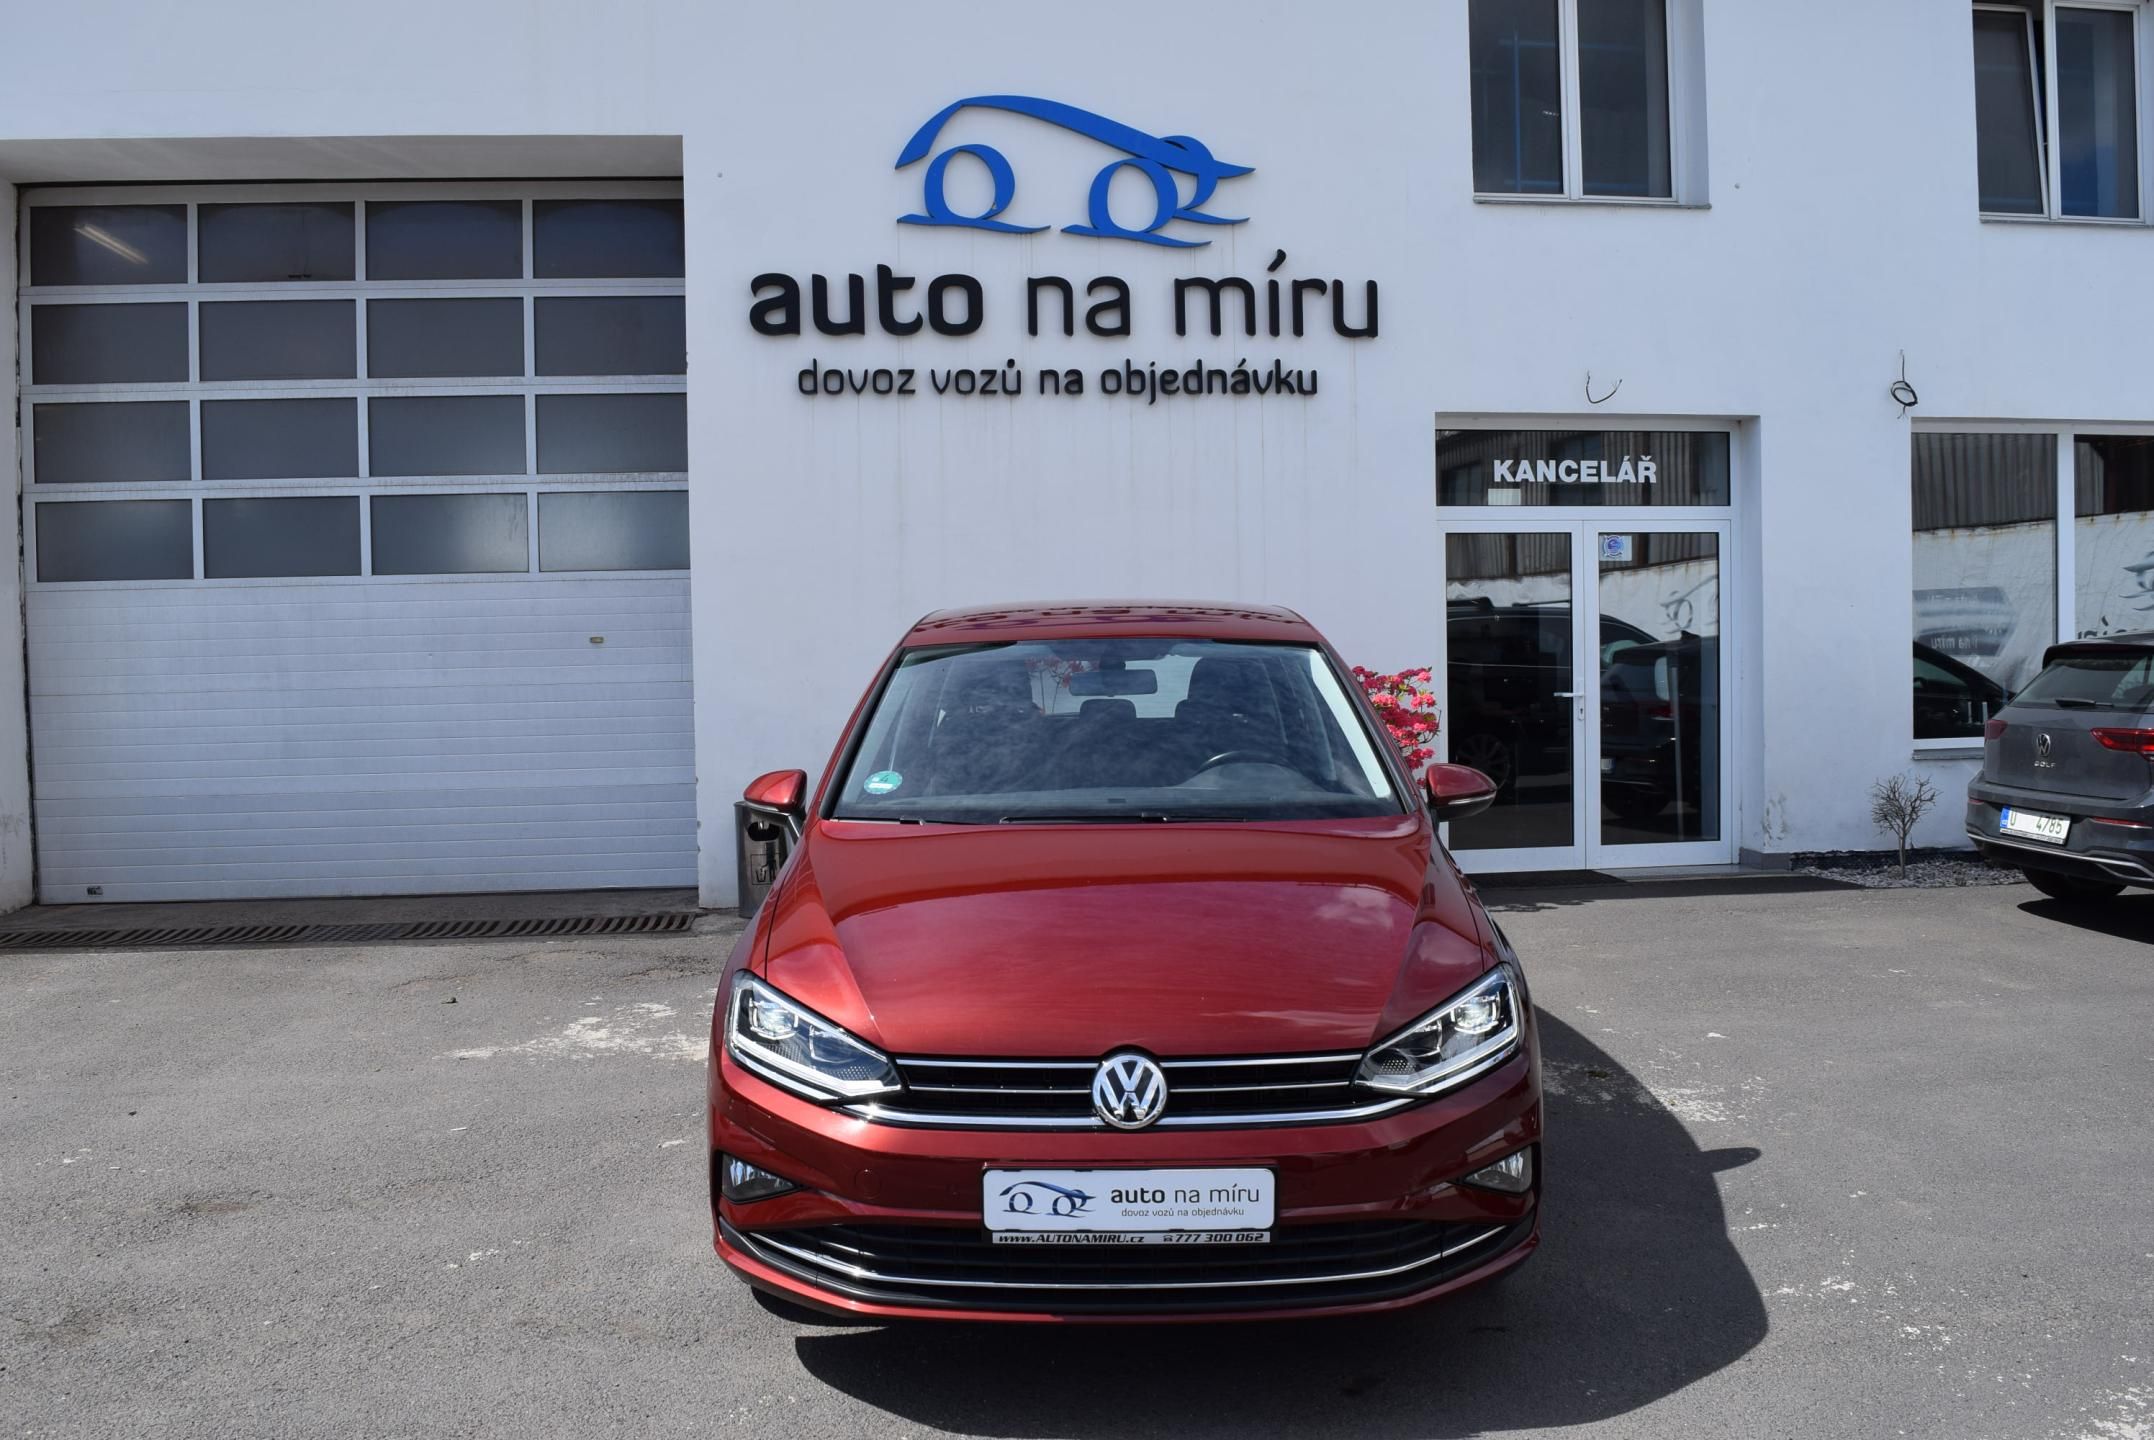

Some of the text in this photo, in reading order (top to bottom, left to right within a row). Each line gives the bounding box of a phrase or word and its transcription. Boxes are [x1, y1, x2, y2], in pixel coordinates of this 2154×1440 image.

[749, 249, 1379, 339] auto na míru
[798, 358, 1319, 406] dovoz vozů na objednávku
[1494, 456, 1657, 483] KANCELÁŘ
[1110, 1183, 1260, 1204] auto na míru
[1121, 1207, 1245, 1218] dovoz vozů na objednávku
[998, 1232, 1265, 1244] www.AUTONAMIRU.cz 777 300 062
